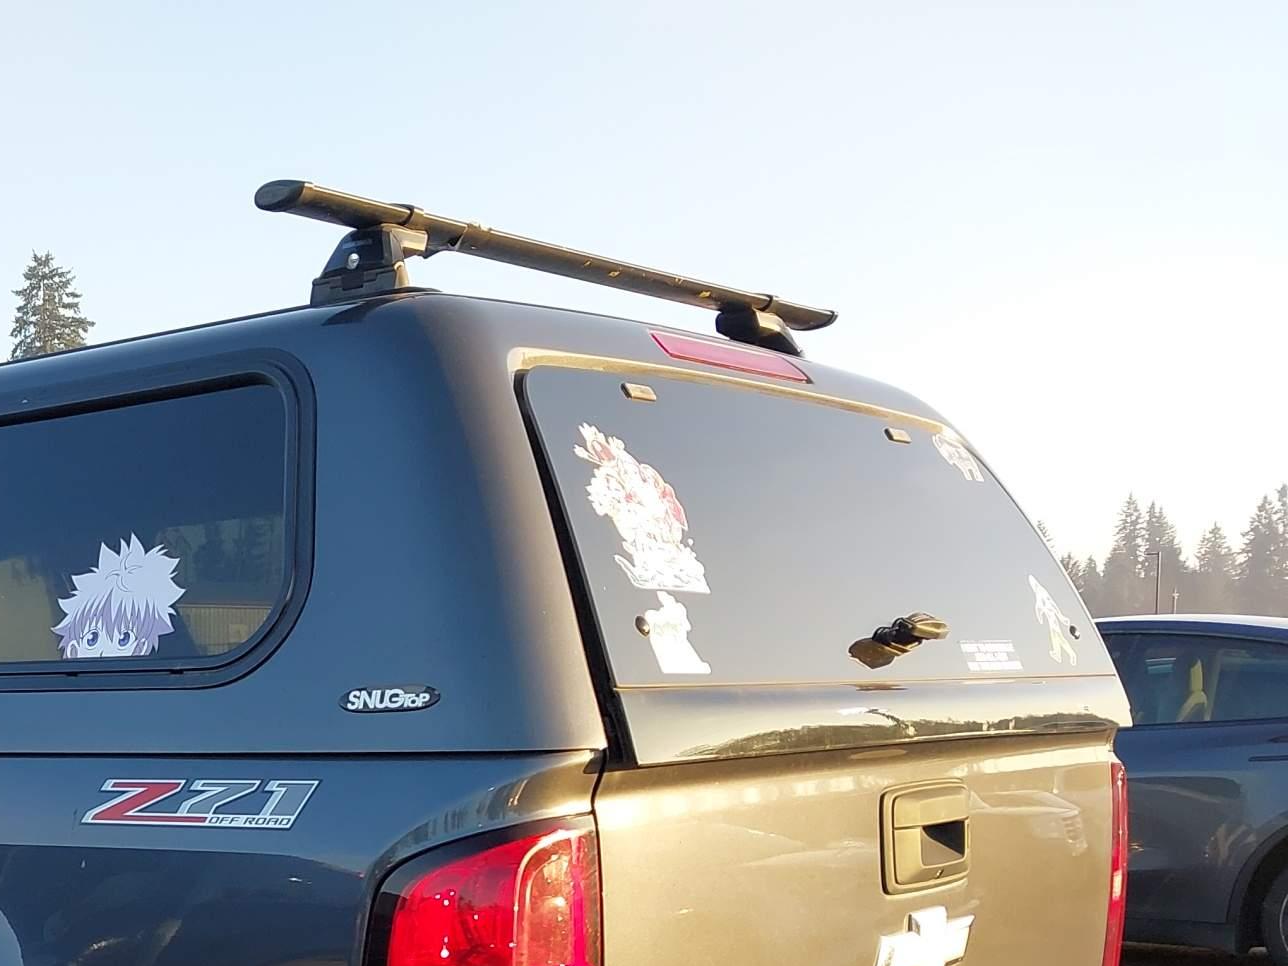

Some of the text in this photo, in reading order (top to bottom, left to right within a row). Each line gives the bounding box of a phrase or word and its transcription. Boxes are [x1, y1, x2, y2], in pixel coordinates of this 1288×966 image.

[80, 778, 321, 829] Z71
[208, 815, 292, 827] OFF ROAD
